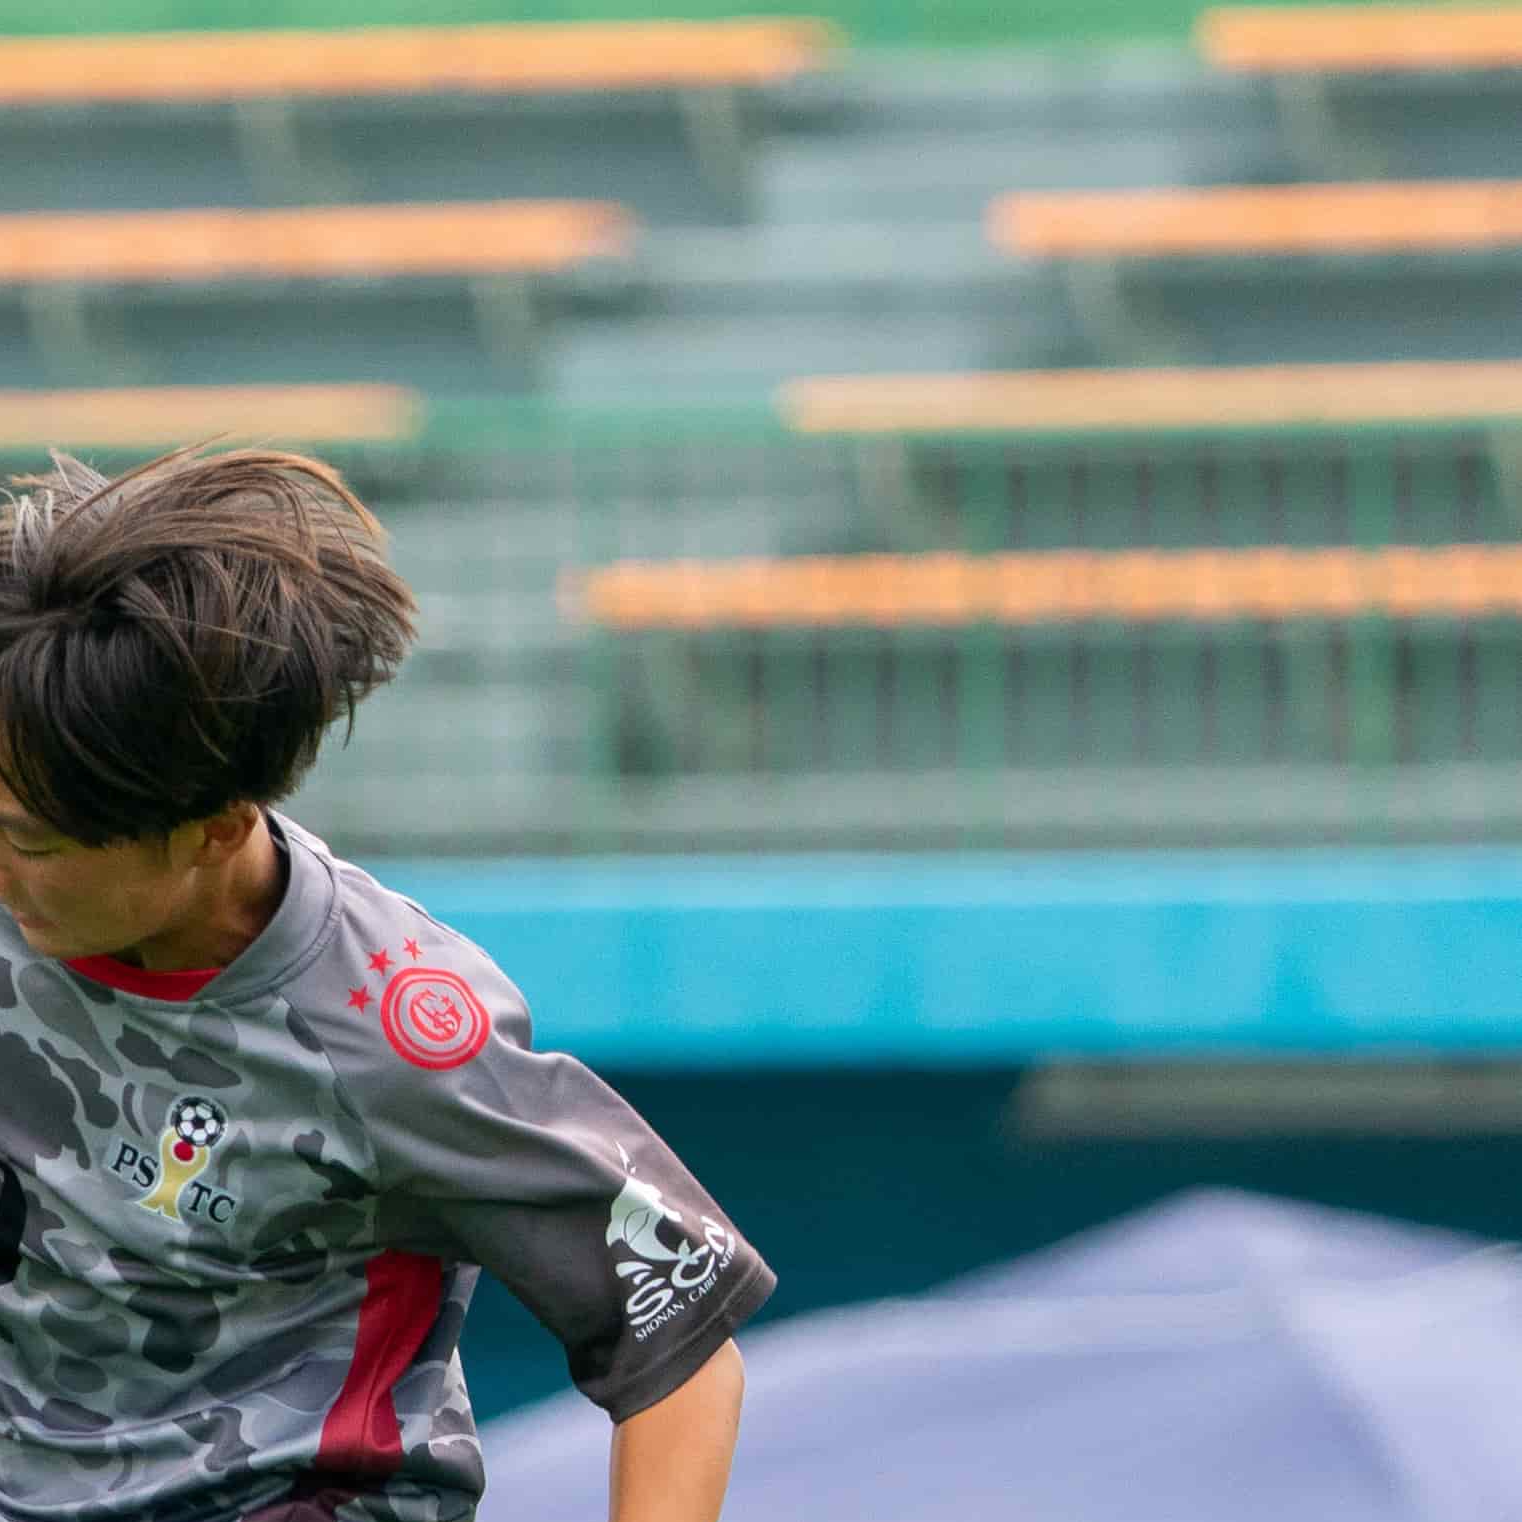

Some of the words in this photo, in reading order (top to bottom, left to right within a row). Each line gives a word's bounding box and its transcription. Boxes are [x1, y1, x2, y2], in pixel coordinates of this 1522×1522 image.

[111, 1141, 159, 1190] PS
[187, 1181, 236, 1225] TC
[634, 1299, 686, 1342] SHONAN
